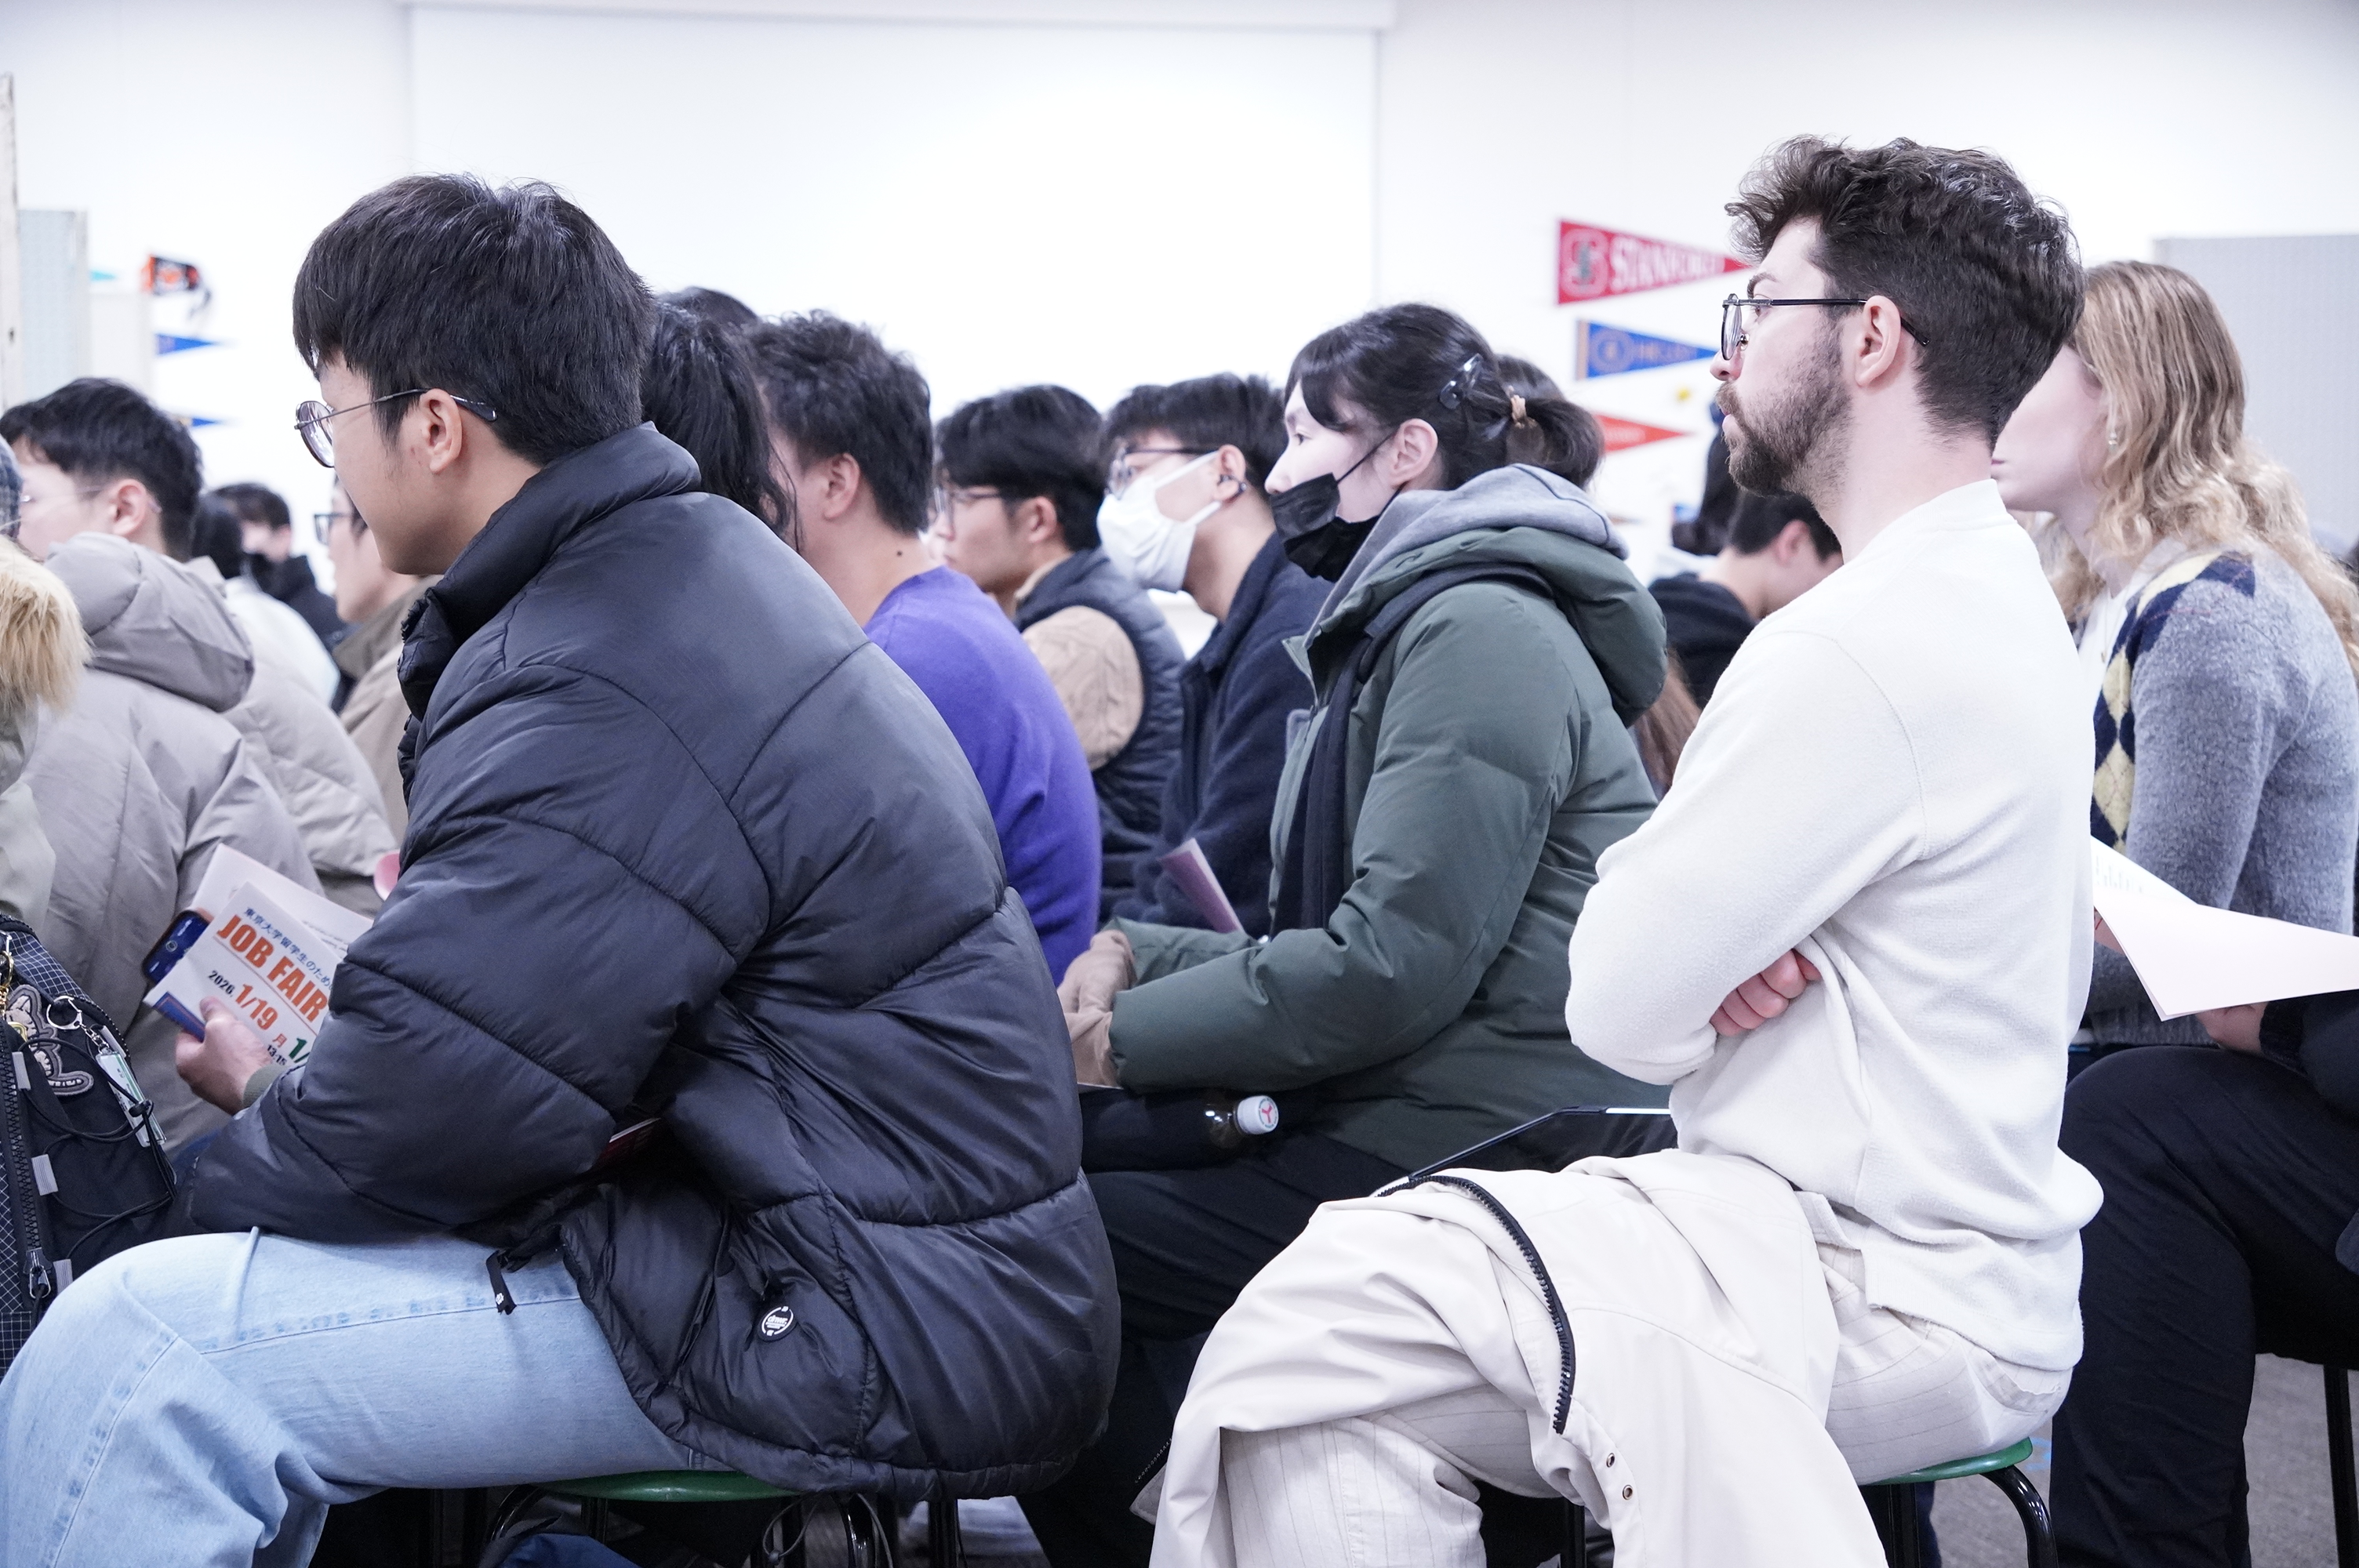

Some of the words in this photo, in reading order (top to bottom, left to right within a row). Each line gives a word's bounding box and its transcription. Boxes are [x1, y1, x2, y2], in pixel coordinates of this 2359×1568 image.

[216, 915, 274, 968] JOB
[267, 956, 327, 1022] FAIR
[235, 983, 278, 1030] 1/19
[272, 1033, 287, 1047] 月
